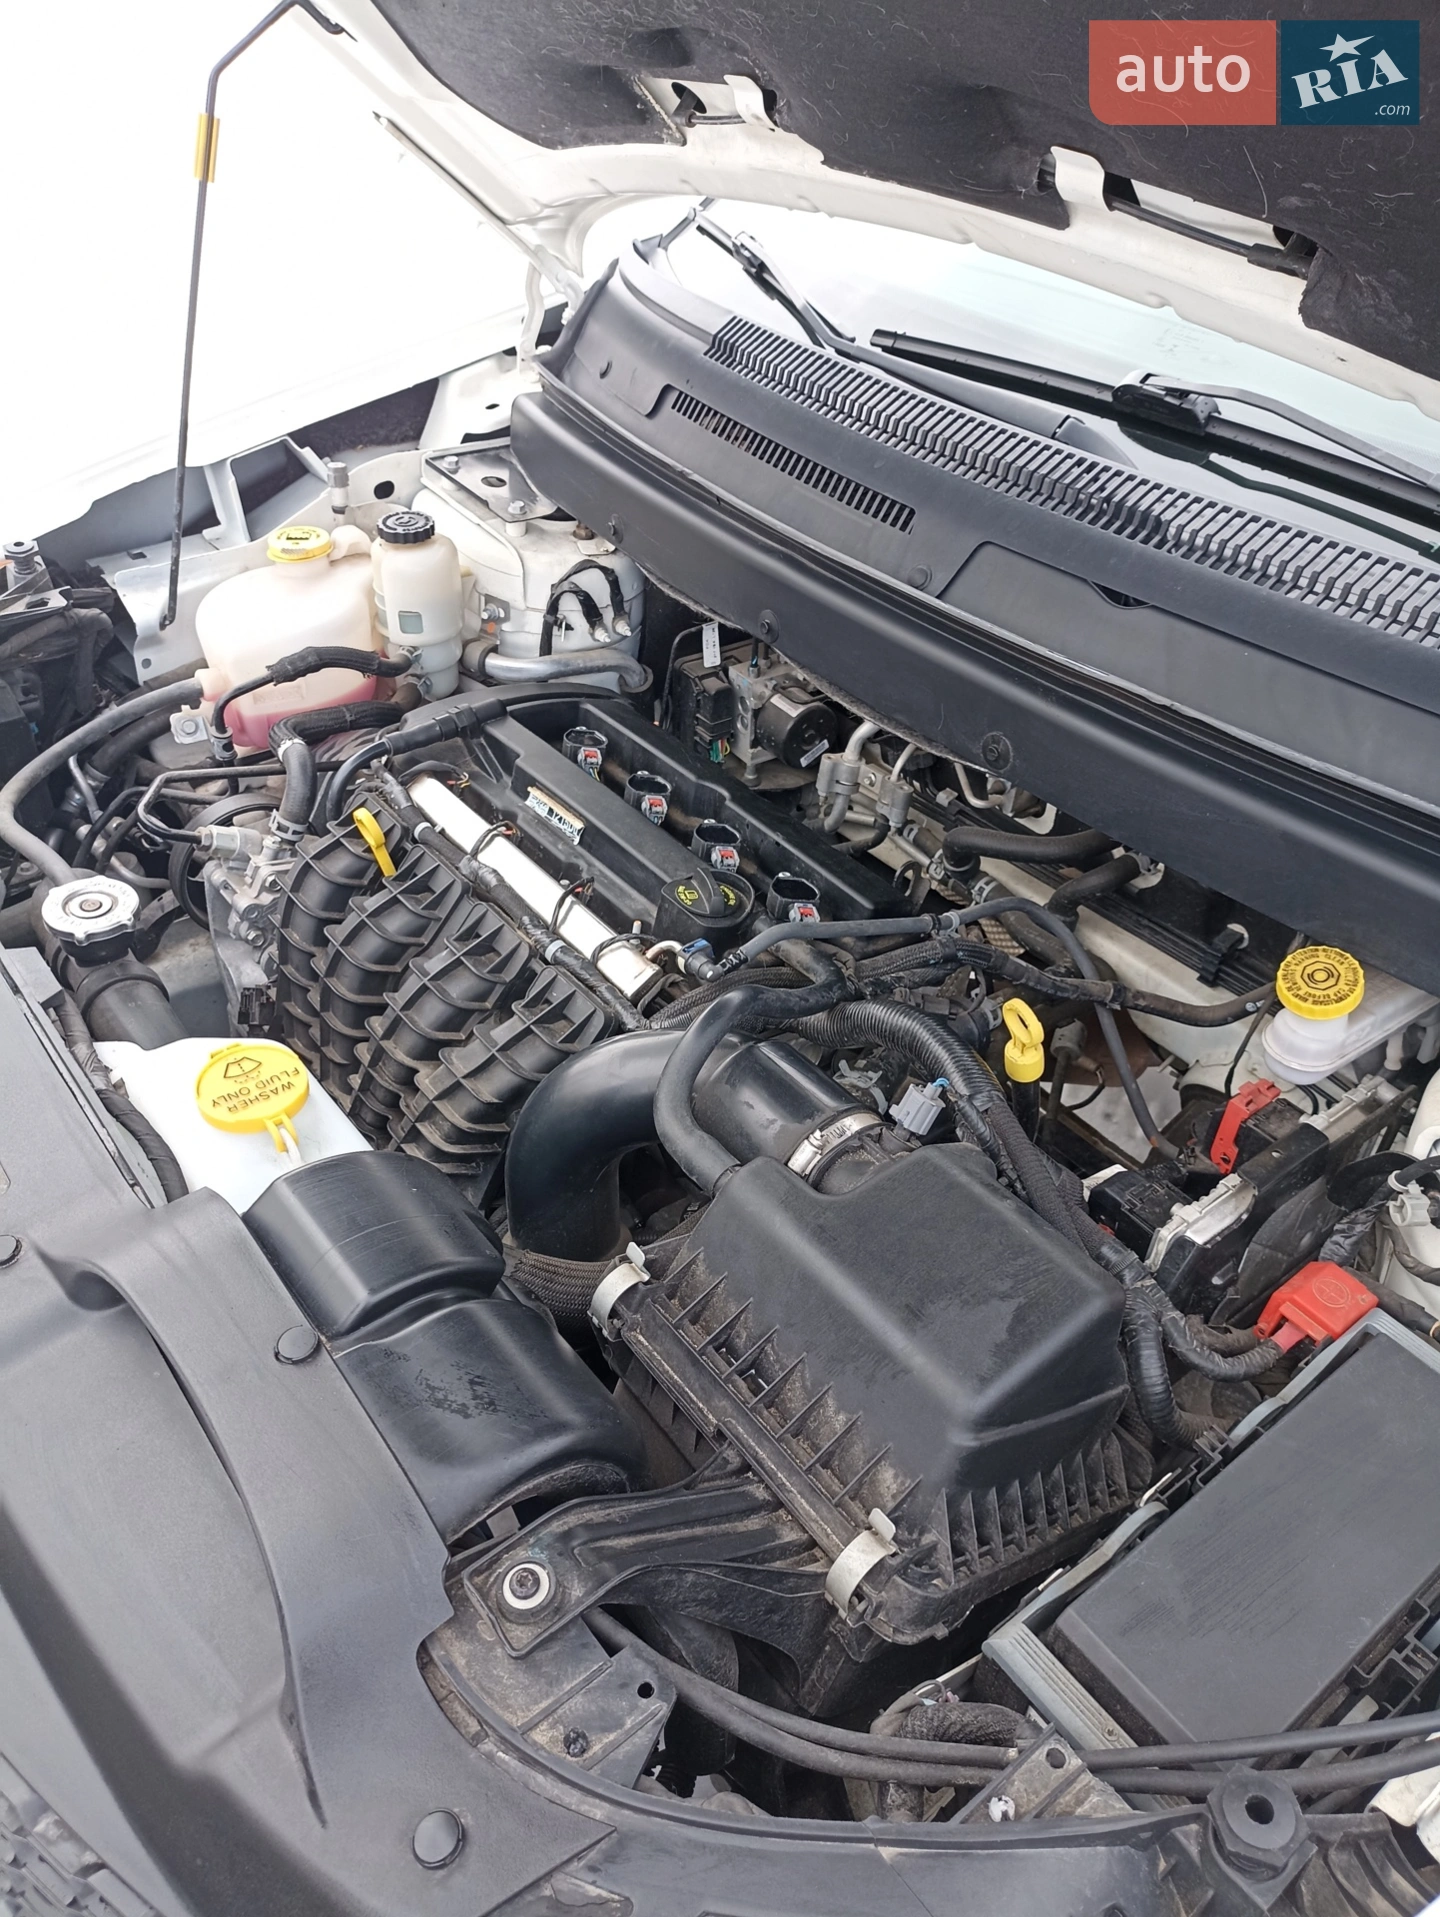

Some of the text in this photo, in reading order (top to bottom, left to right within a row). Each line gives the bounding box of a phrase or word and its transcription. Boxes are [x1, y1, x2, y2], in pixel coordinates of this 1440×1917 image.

[211, 1067, 300, 1109] FLUID ONLY
[226, 1081, 295, 1114] WASHER
